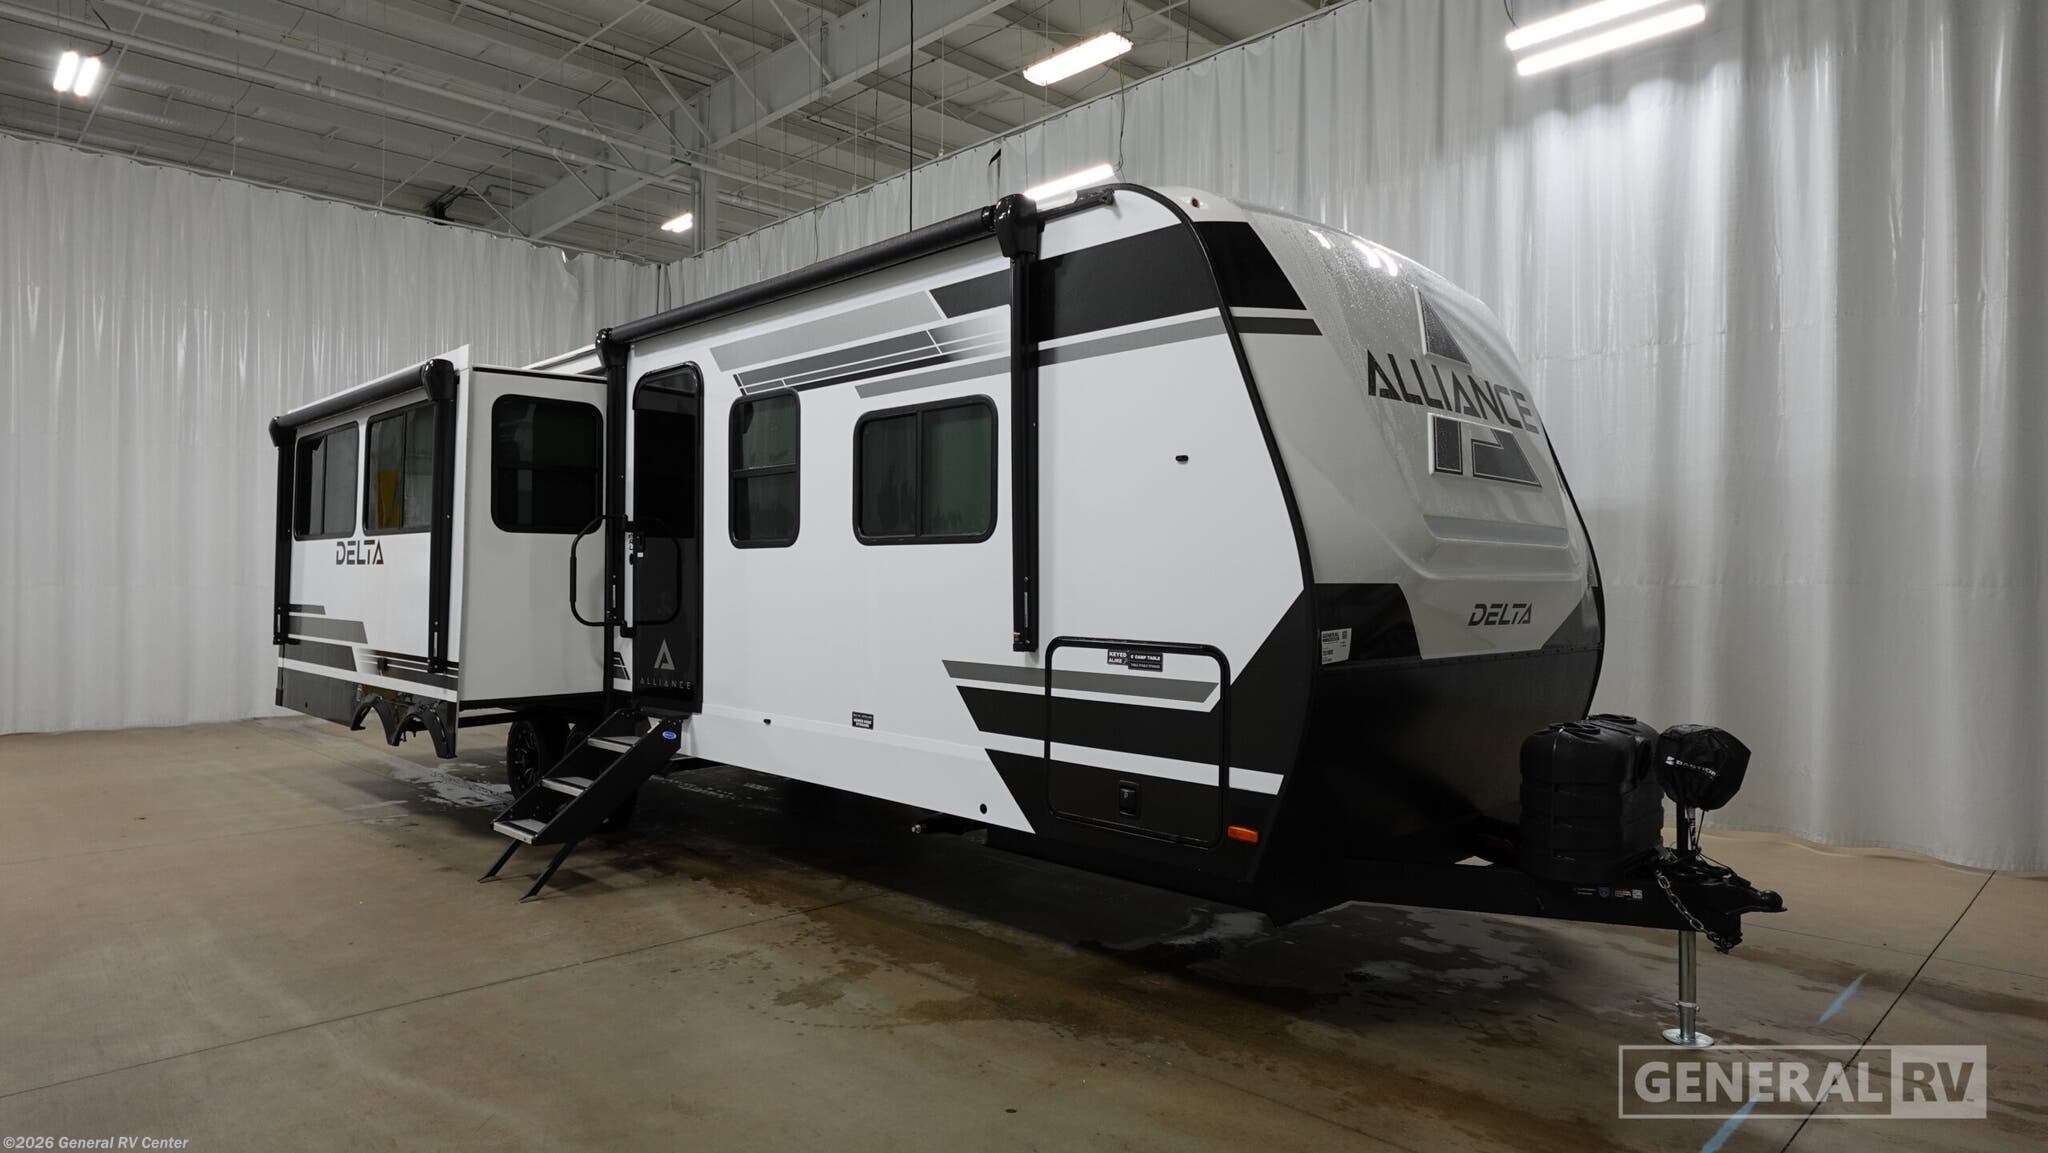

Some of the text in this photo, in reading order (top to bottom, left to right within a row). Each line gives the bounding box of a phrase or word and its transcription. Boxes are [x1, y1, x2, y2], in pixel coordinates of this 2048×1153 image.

[1367, 348, 1540, 434] ALLIANCE
[335, 539, 385, 565] DELTA
[1467, 603, 1532, 626] DELTA
[640, 677, 692, 690] ALLIANCE
